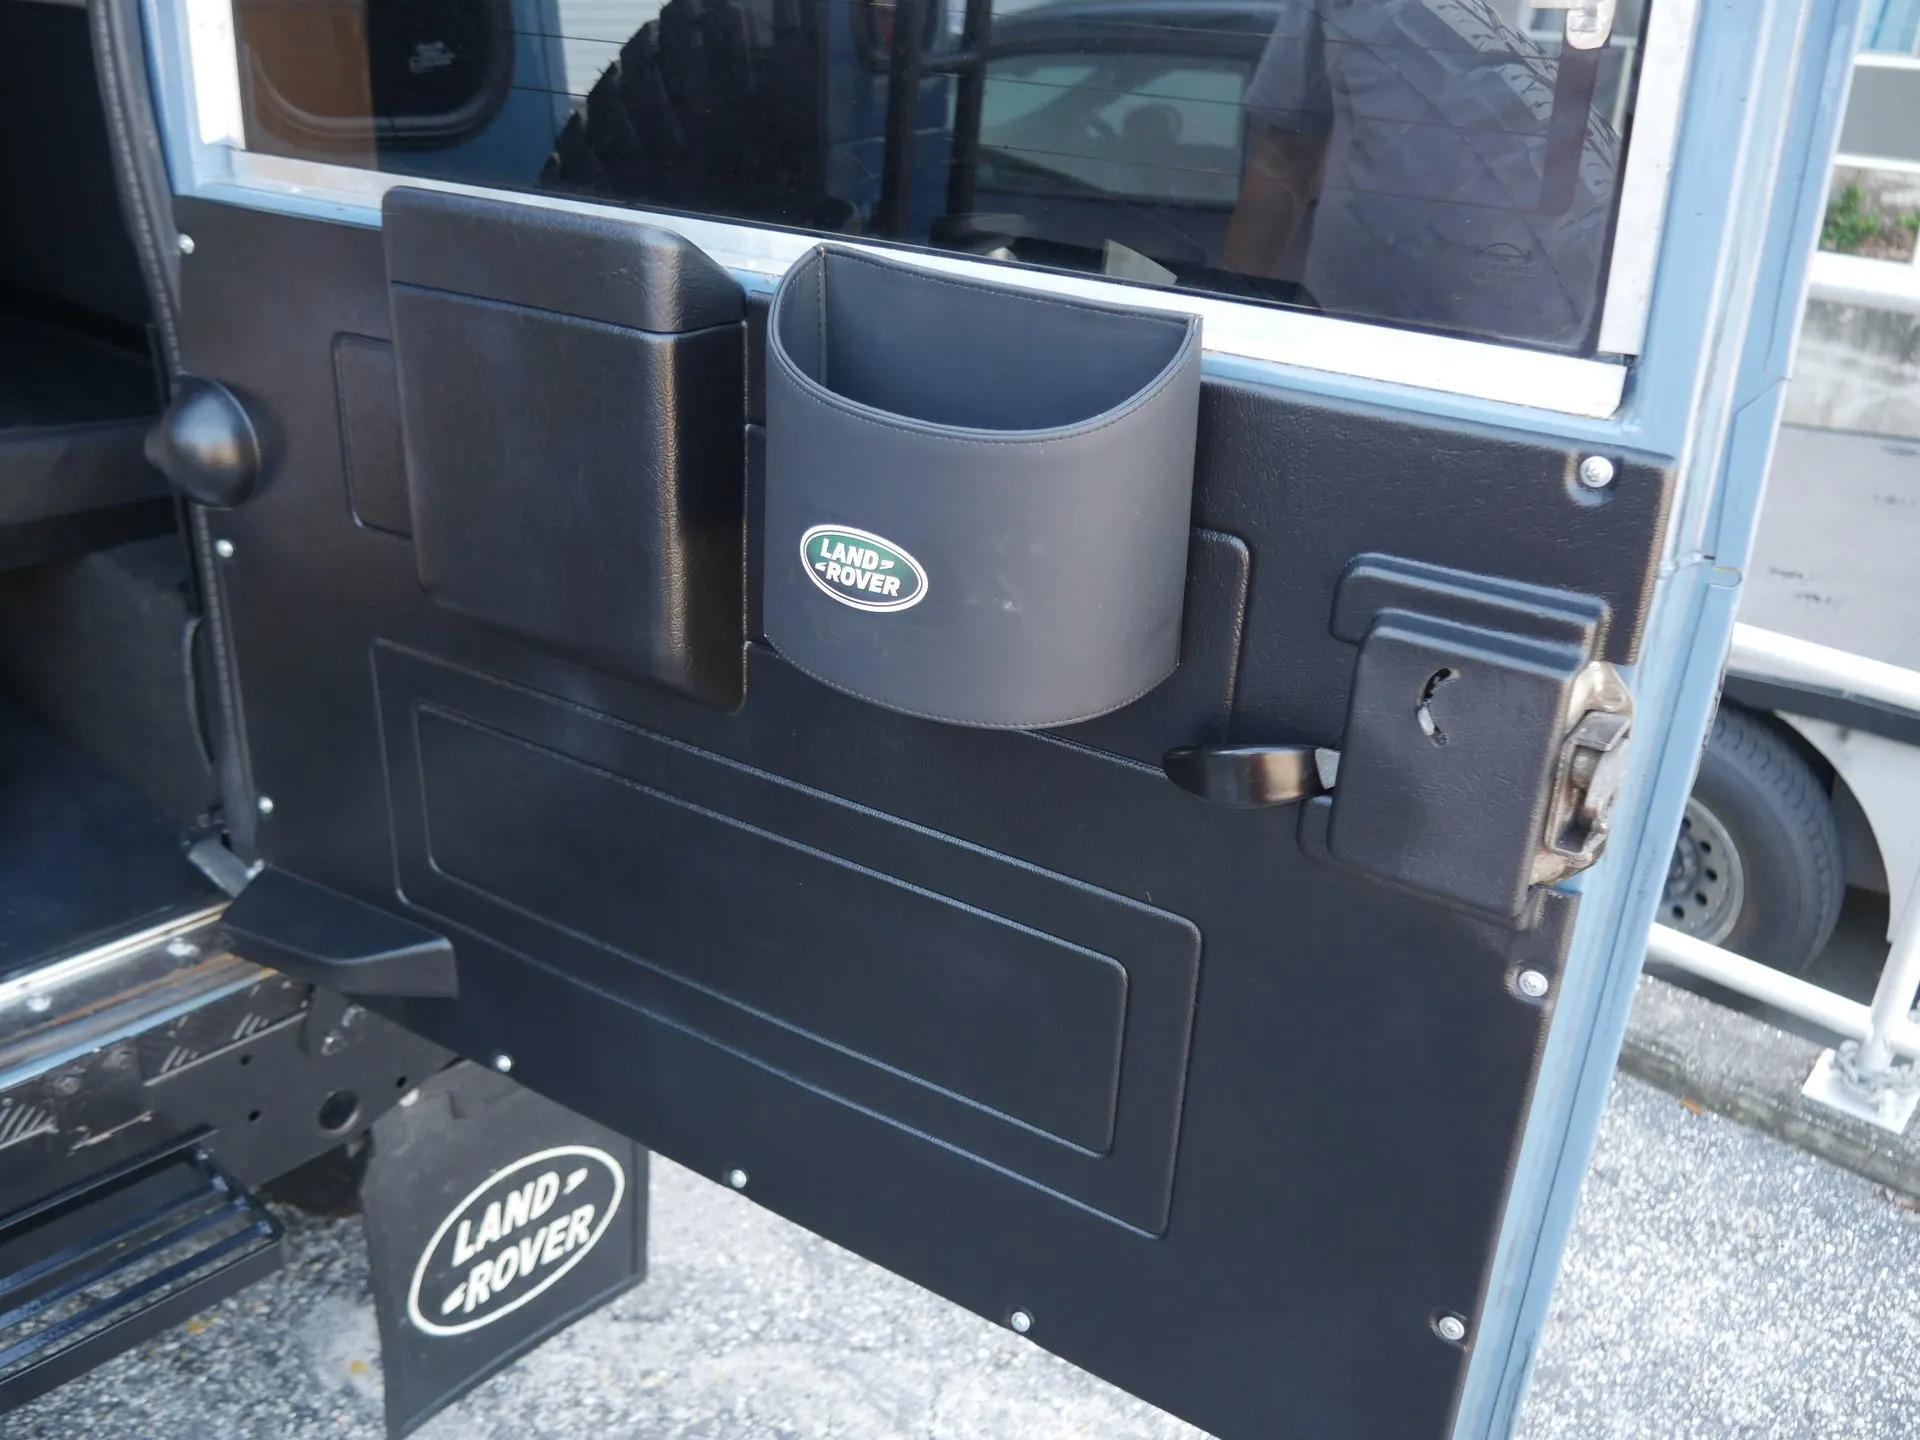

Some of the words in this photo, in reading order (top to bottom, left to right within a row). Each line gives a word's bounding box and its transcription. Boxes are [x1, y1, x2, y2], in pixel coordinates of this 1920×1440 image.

[820, 538, 880, 571] LAND
[825, 560, 901, 597] ROVER
[452, 1171, 560, 1267] LAND
[464, 1204, 596, 1313] ROVER
